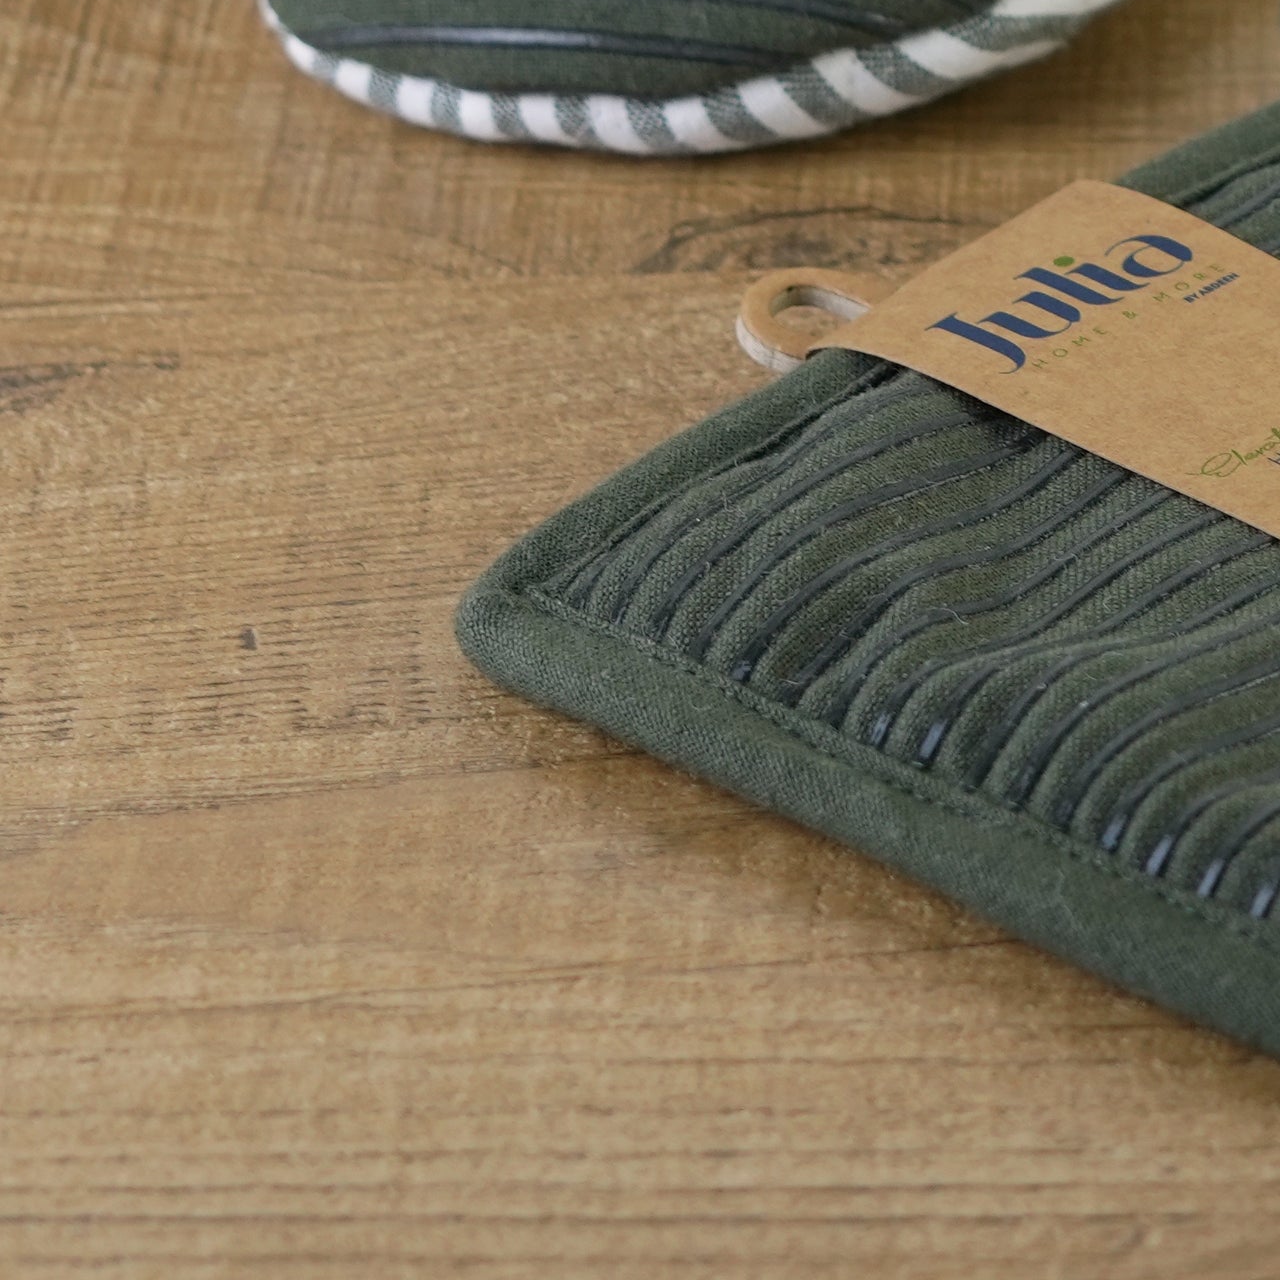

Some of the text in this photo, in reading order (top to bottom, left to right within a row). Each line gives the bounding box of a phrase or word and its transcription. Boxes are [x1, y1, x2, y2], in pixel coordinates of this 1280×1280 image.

[924, 235, 1193, 374] Julia
[1032, 326, 1107, 369] HOME
[1153, 263, 1225, 302] MORE
[1183, 292, 1200, 304] BY
